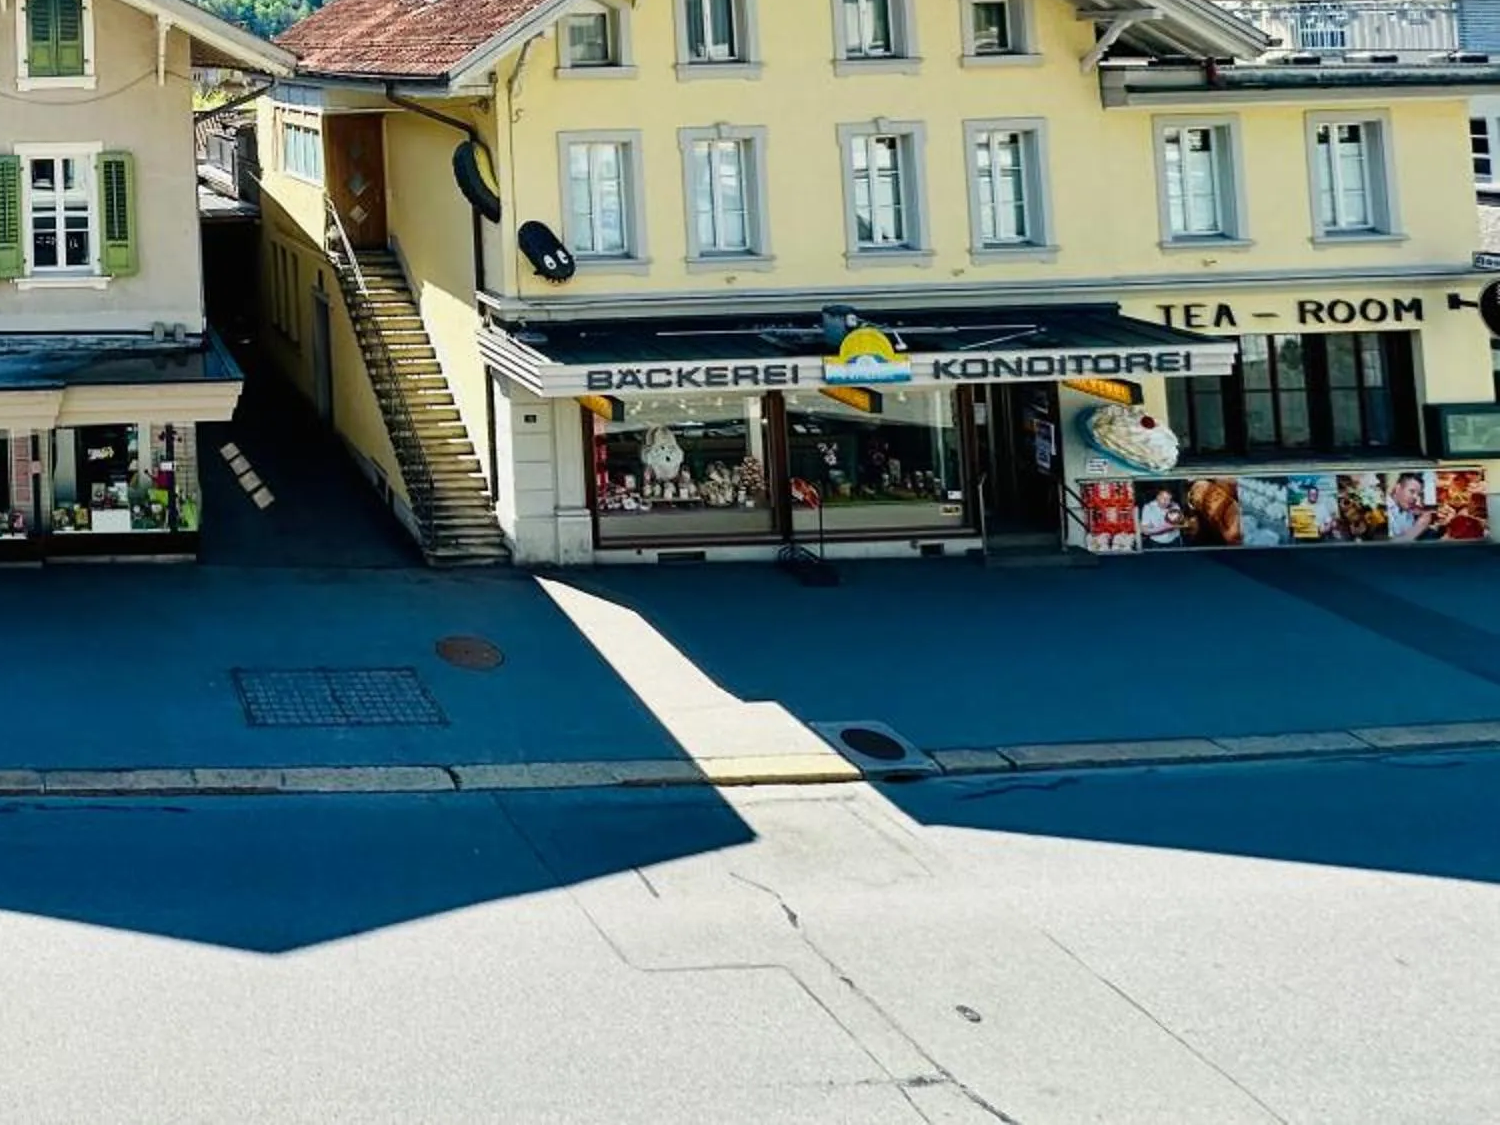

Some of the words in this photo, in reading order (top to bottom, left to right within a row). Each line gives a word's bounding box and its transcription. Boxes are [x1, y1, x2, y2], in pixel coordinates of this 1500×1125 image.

[1156, 303, 1237, 328] TEA
[1297, 298, 1424, 325] ROOM
[587, 364, 799, 391] BÄCKEREI
[933, 351, 1192, 380] KONDITOREI
